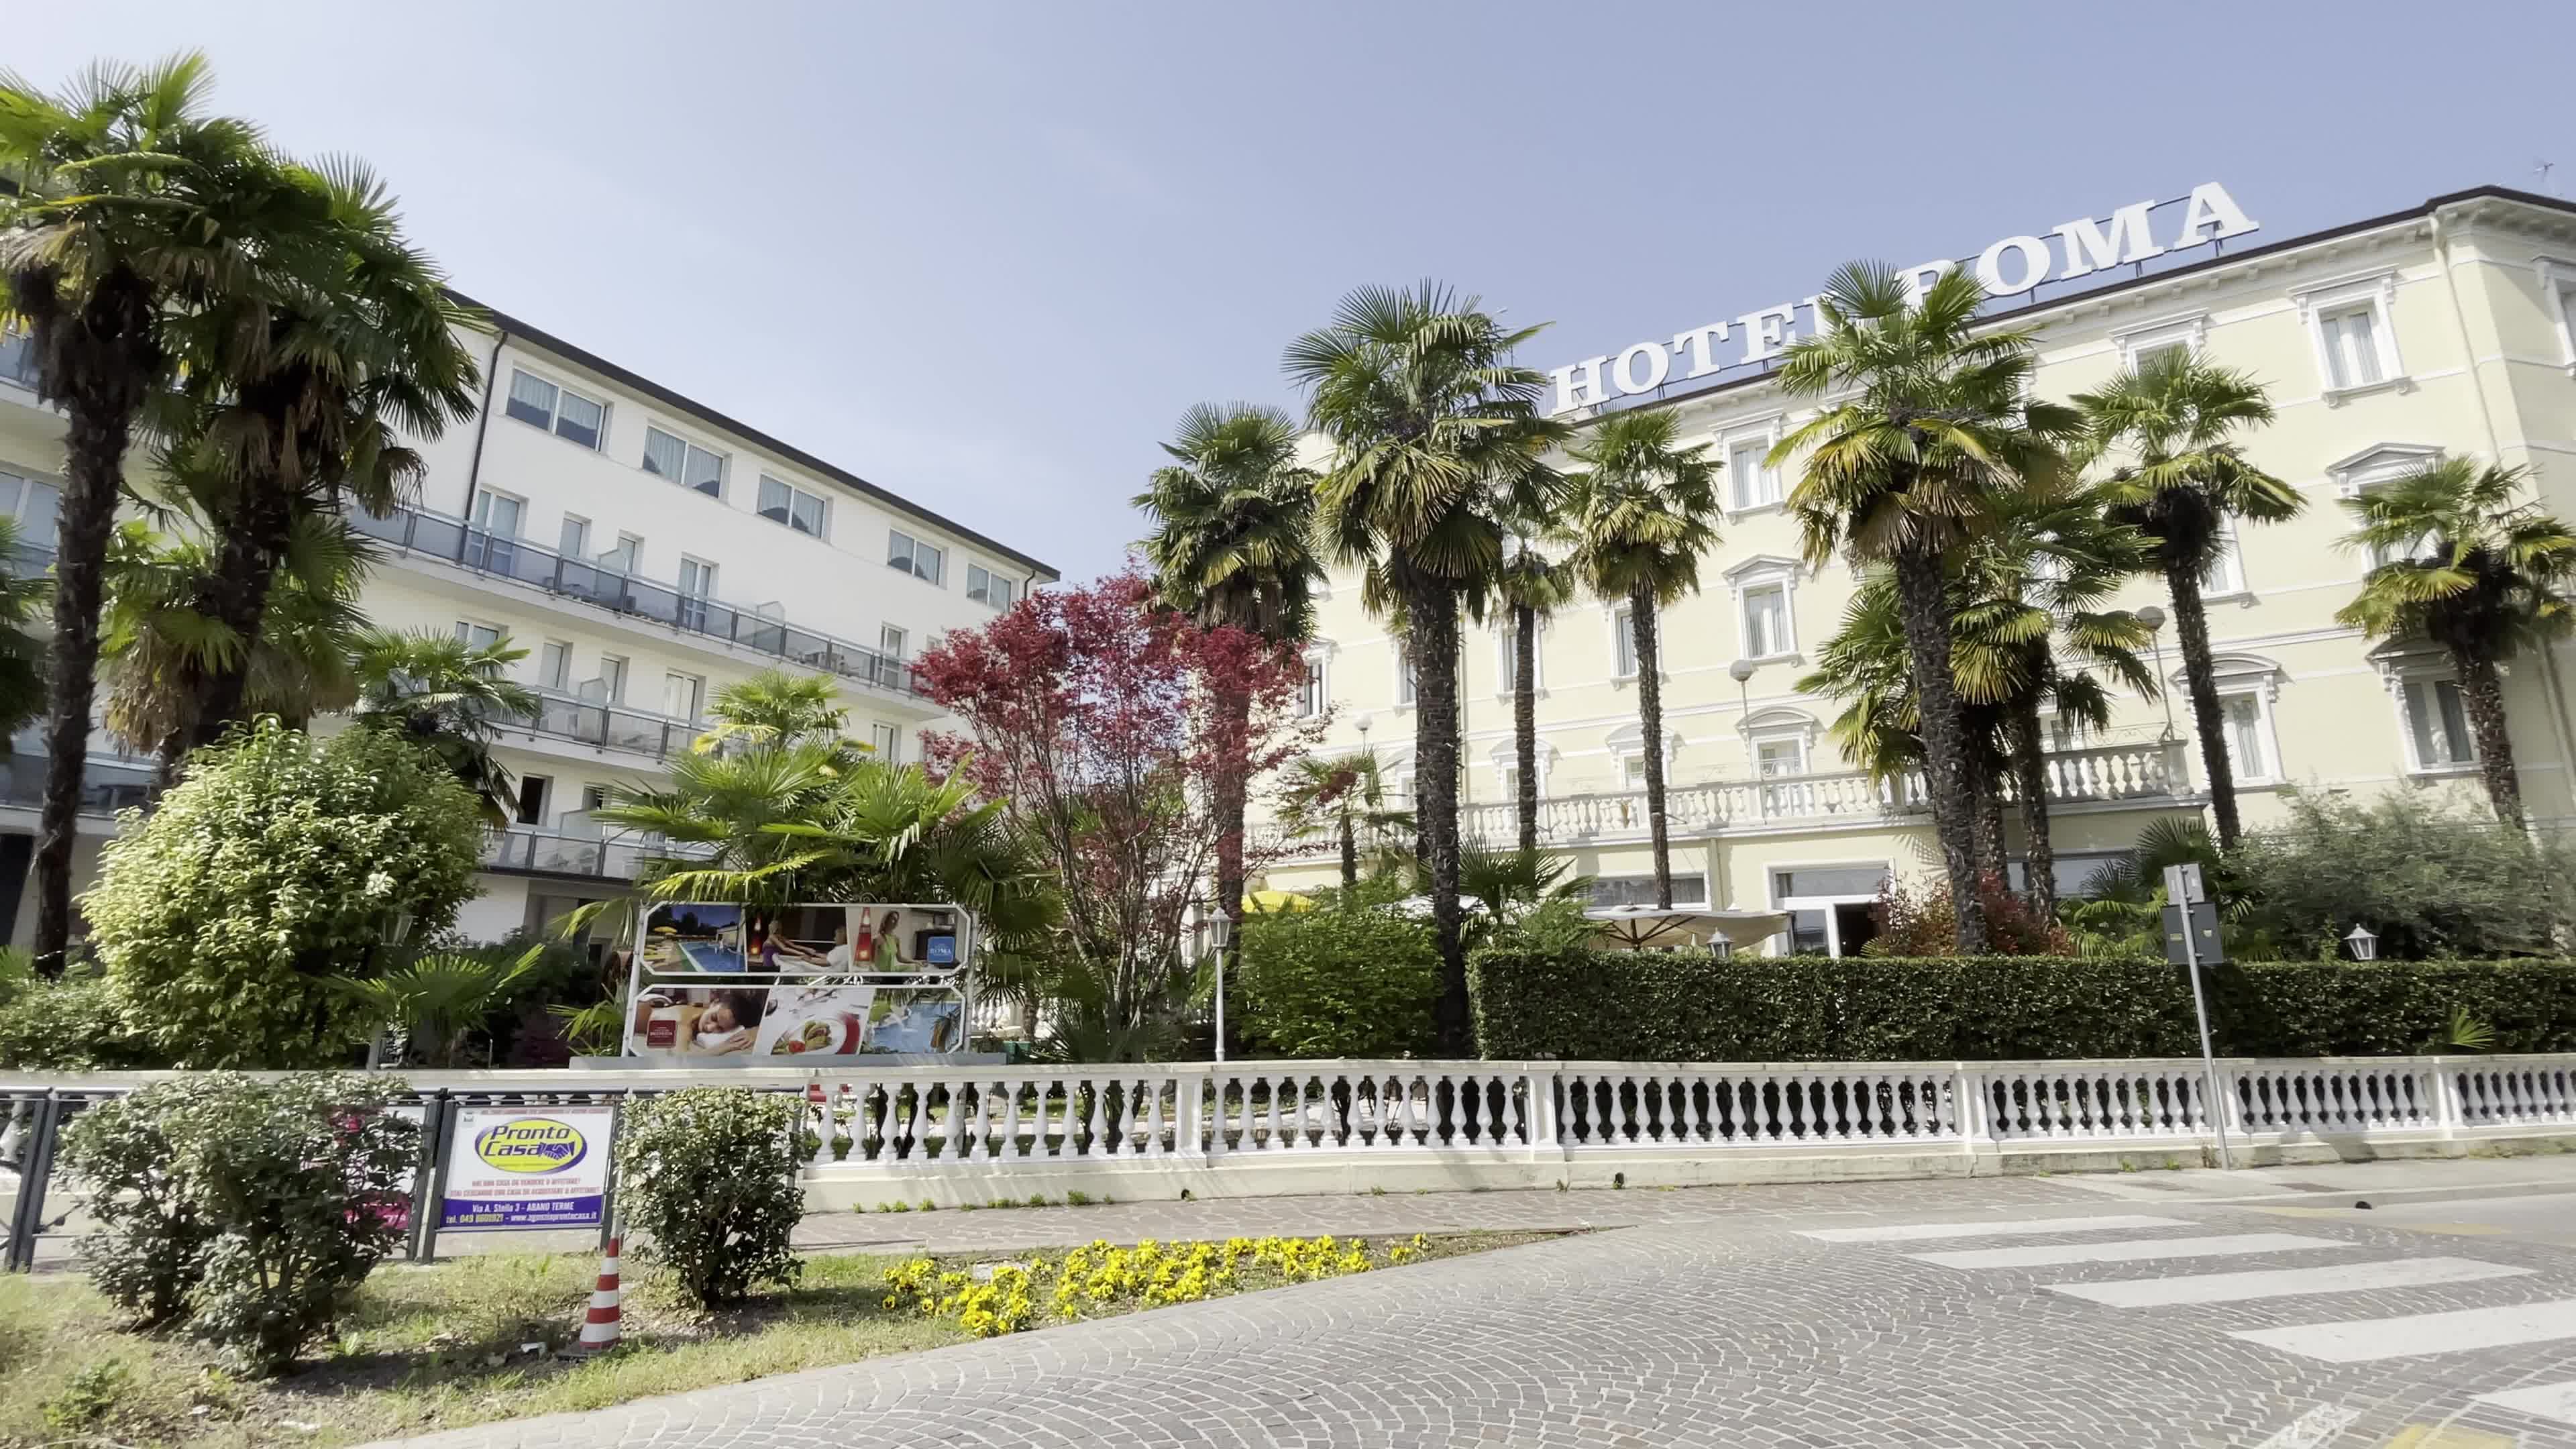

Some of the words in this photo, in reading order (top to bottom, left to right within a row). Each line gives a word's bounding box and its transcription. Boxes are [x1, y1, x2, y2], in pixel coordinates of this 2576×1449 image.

[490, 1126, 570, 1140] Pronto
[484, 1141, 541, 1156] Casa
[472, 1204, 483, 1213] Via
[484, 1204, 492, 1212] A.
[515, 1203, 521, 1212] 3
[526, 1202, 551, 1212] ABANO
[552, 1201, 575, 1211] TERME
[445, 1215, 457, 1224] tel.
[460, 1214, 474, 1224] 049
